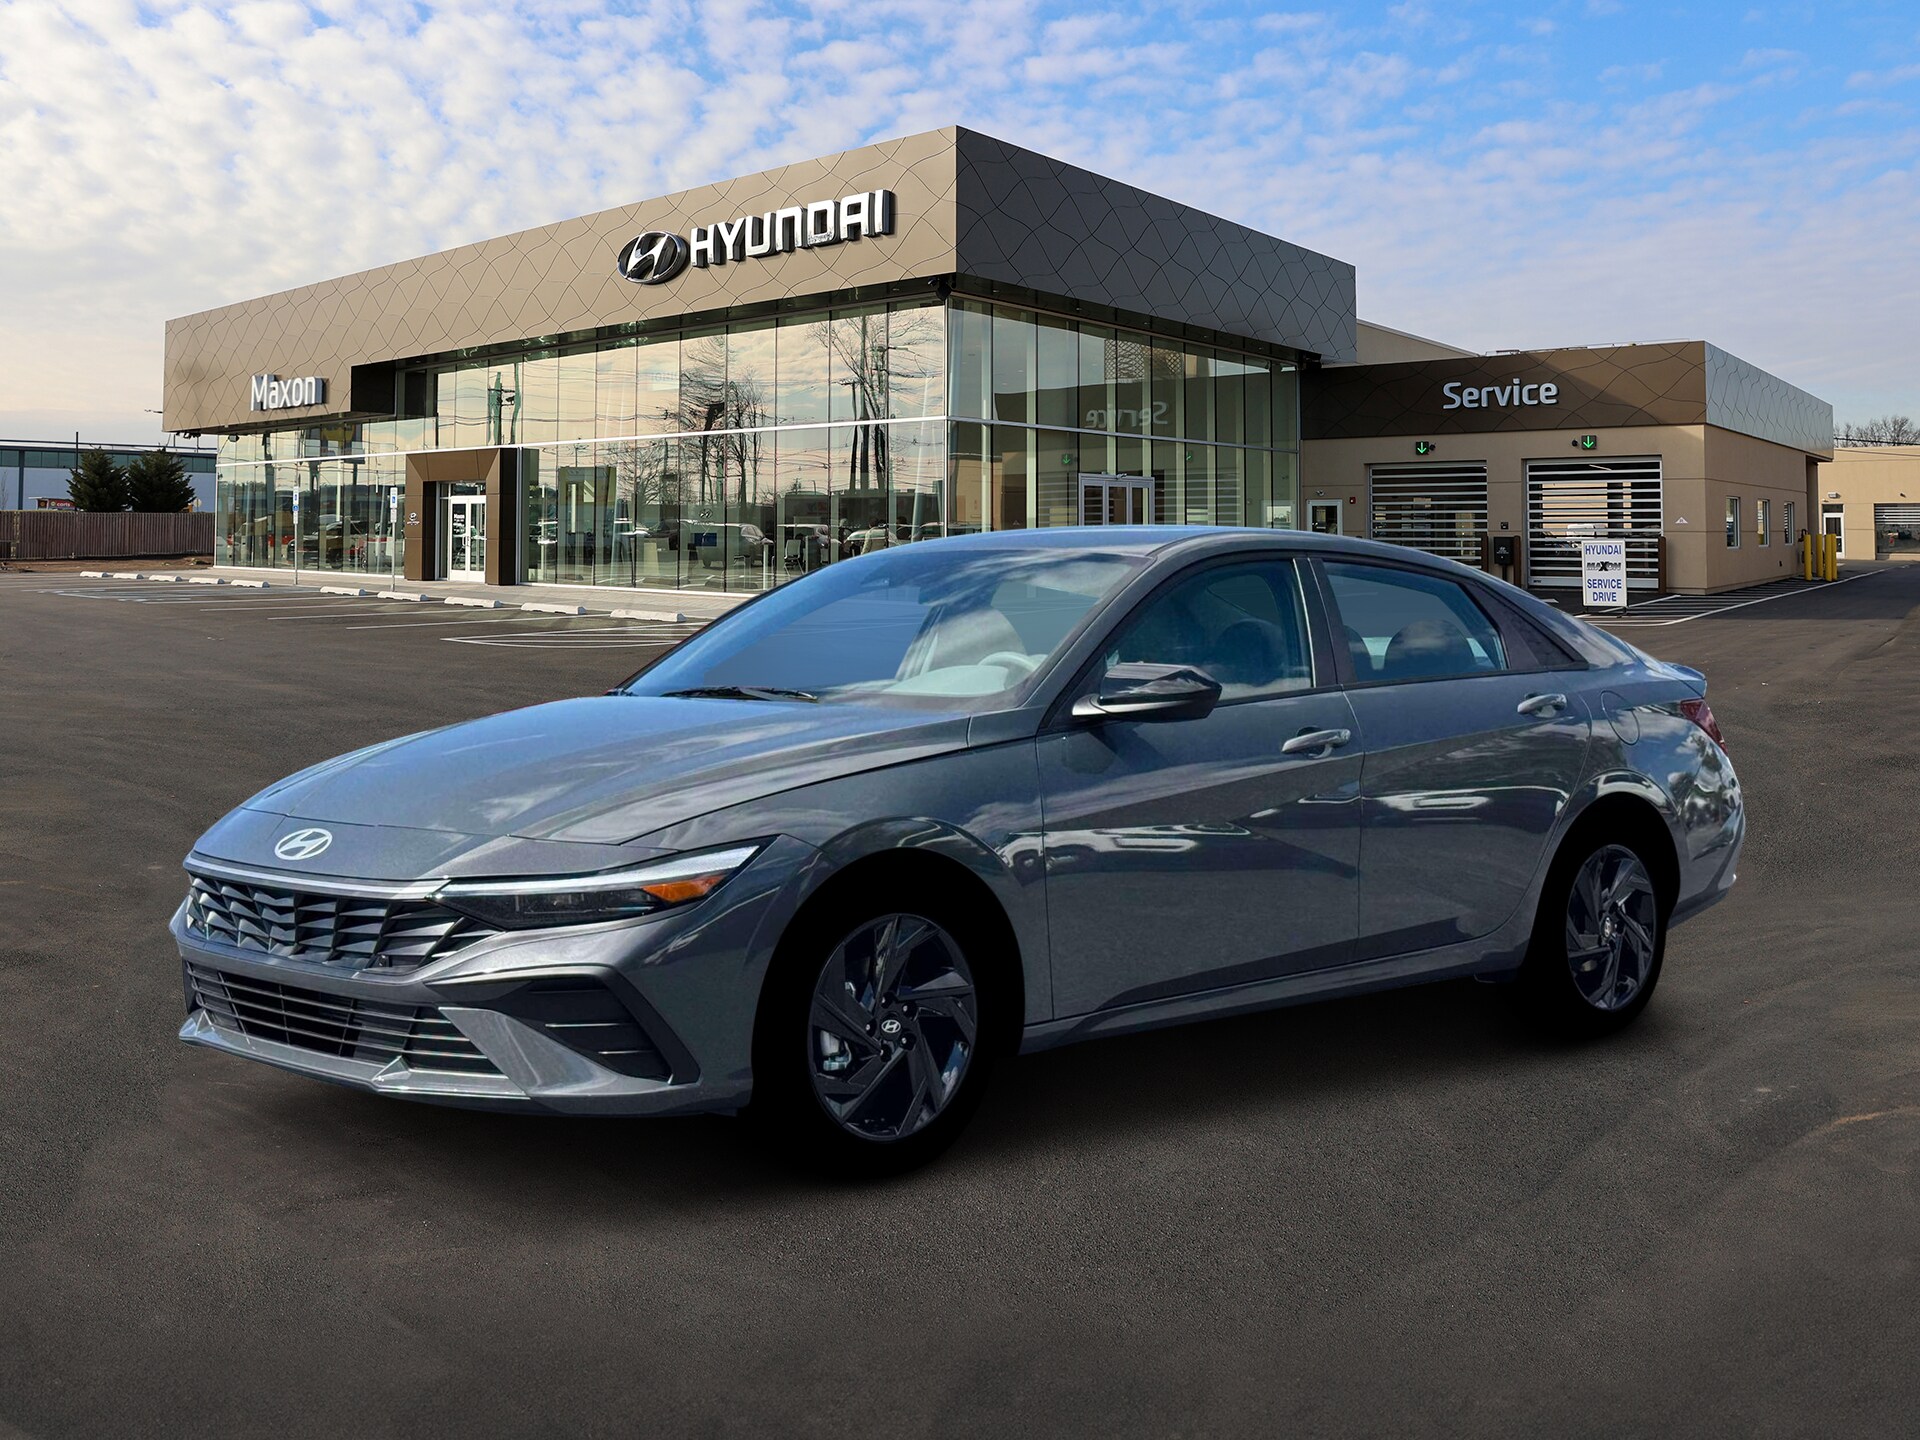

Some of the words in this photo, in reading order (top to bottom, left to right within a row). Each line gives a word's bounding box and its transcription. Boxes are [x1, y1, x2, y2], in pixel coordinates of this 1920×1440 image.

[690, 189, 891, 267] HYUNDAI
[250, 374, 321, 411] Maxon
[1443, 378, 1558, 409] Service
[1585, 544, 1622, 555] HYUNDAI
[1586, 561, 1622, 572] MAXON
[1586, 578, 1622, 589] SERVICE
[1592, 591, 1617, 602] DRIVE
